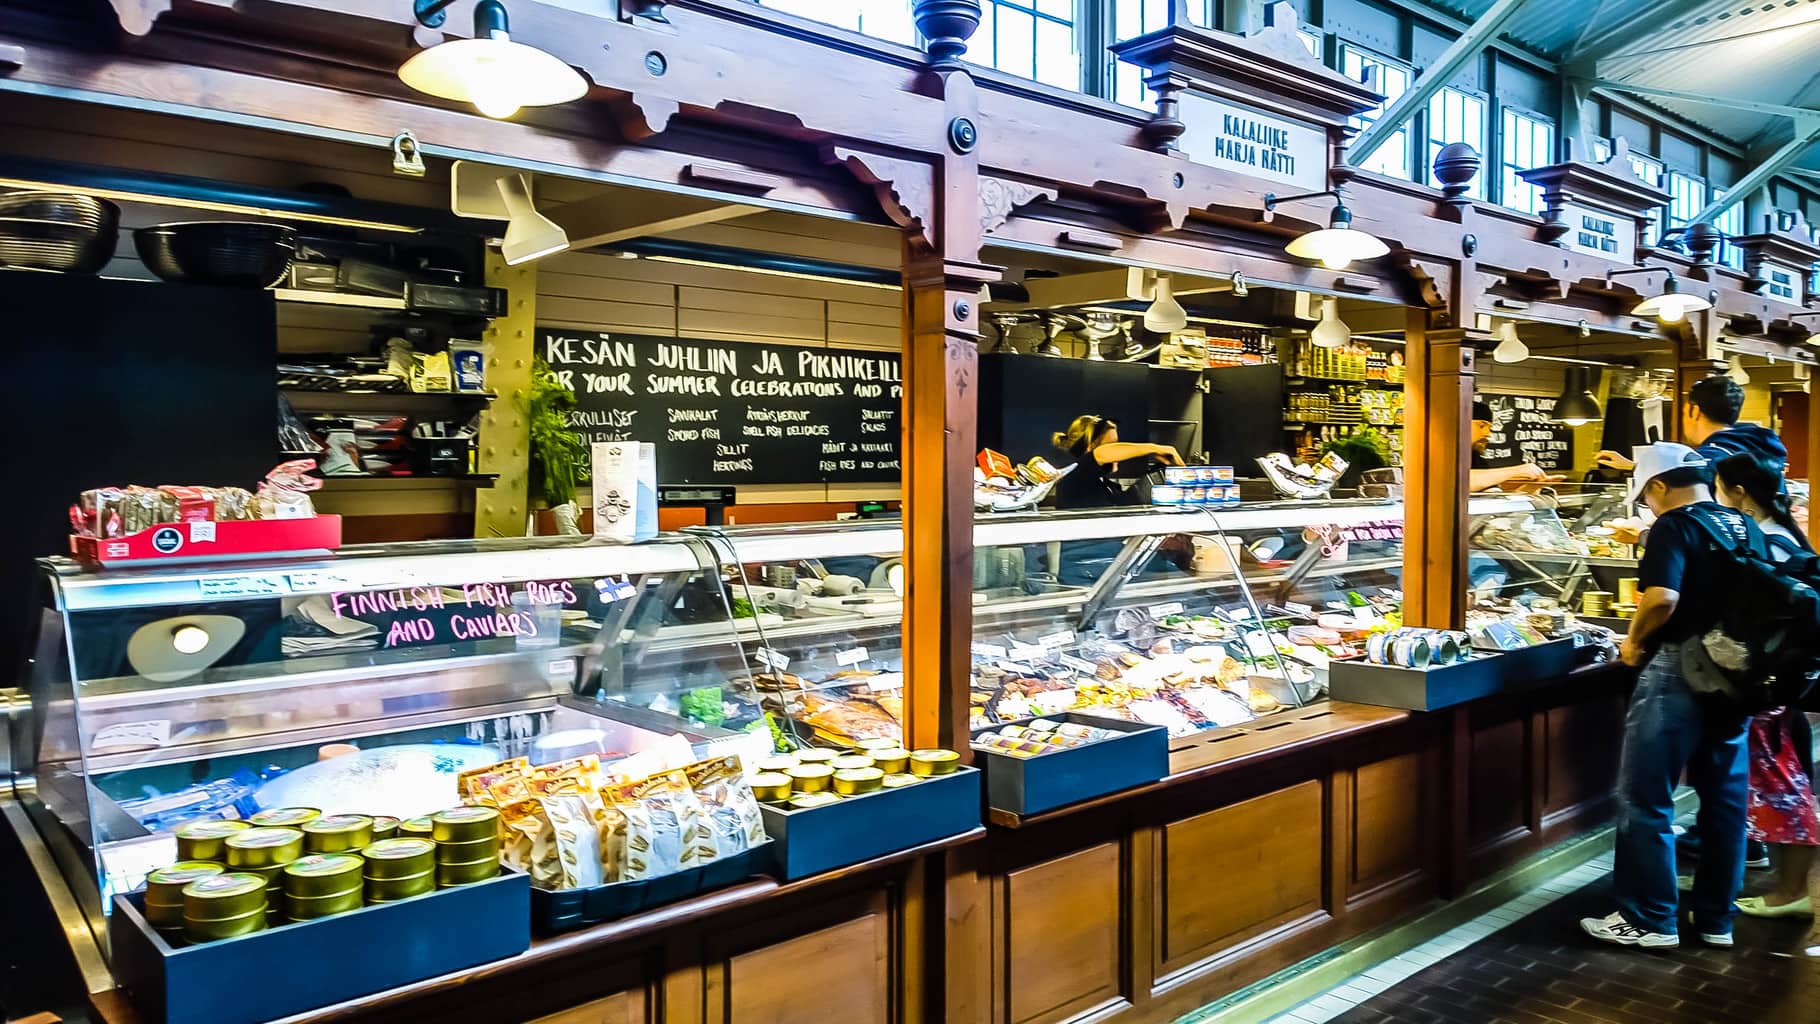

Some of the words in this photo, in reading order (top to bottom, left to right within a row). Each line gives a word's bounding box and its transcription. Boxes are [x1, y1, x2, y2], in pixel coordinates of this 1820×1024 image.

[1223, 113, 1289, 150] KALALIIKE
[1215, 136, 1256, 166] MARJA
[1261, 147, 1295, 176] NÄTTI
[546, 333, 637, 367] KESÄN
[647, 343, 738, 376] JUHLIIN
[751, 349, 785, 376] JA
[798, 350, 902, 382] PIKNIKEILL
[543, 369, 575, 392] OR
[581, 372, 635, 395] YOUR
[646, 373, 722, 397] SUMMER
[730, 378, 845, 398] CELEBRATIONS
[853, 383, 883, 398] AND
[701, 427, 721, 441] FISH
[329, 585, 444, 619] FINNISH
[462, 582, 511, 609] FISH
[525, 581, 578, 606] ROES
[387, 617, 435, 647] AND
[450, 610, 538, 641] CAVIARS
